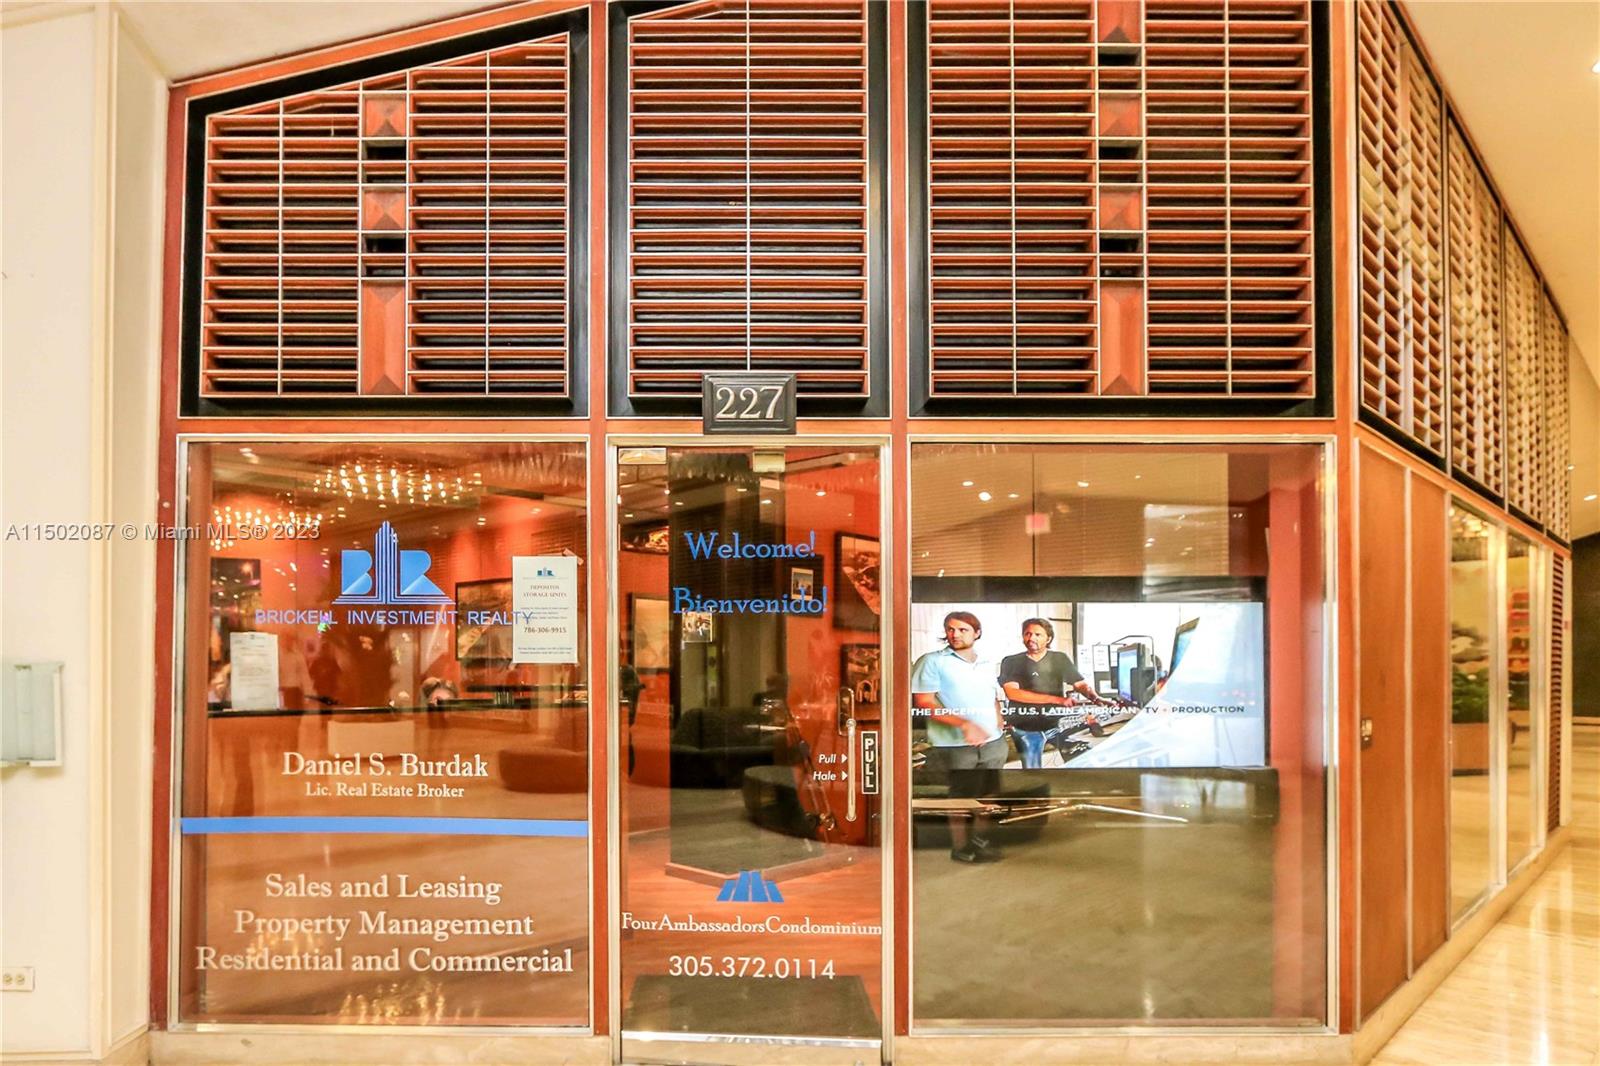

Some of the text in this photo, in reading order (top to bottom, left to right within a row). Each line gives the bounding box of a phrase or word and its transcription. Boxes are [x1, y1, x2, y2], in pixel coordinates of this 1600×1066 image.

[715, 386, 784, 419] 227
[684, 530, 816, 560] Welcome!
[672, 586, 829, 615] Bienvenido!
[255, 609, 533, 626] BRICKELL INVESTMENT REALTY
[911, 708, 931, 717] THE
[1000, 707, 1016, 716] OF
[1018, 707, 1039, 716] U.S.
[1042, 706, 1074, 716] LATIN
[1077, 706, 1138, 716] AMERICAN
[1145, 706, 1159, 714] TV
[1171, 705, 1245, 714] PRODUCTION
[281, 751, 489, 778] Daniel S. Burdak
[818, 753, 837, 764] Pull
[863, 738, 875, 788] PULL
[812, 770, 837, 781] Hale
[305, 781, 465, 799] Lic. Real Estate Broker
[265, 873, 503, 906] Sales and Leasing
[233, 910, 535, 941] Property Management
[195, 946, 574, 974] Residential and Commercial
[668, 955, 836, 980] 305.372.0114
